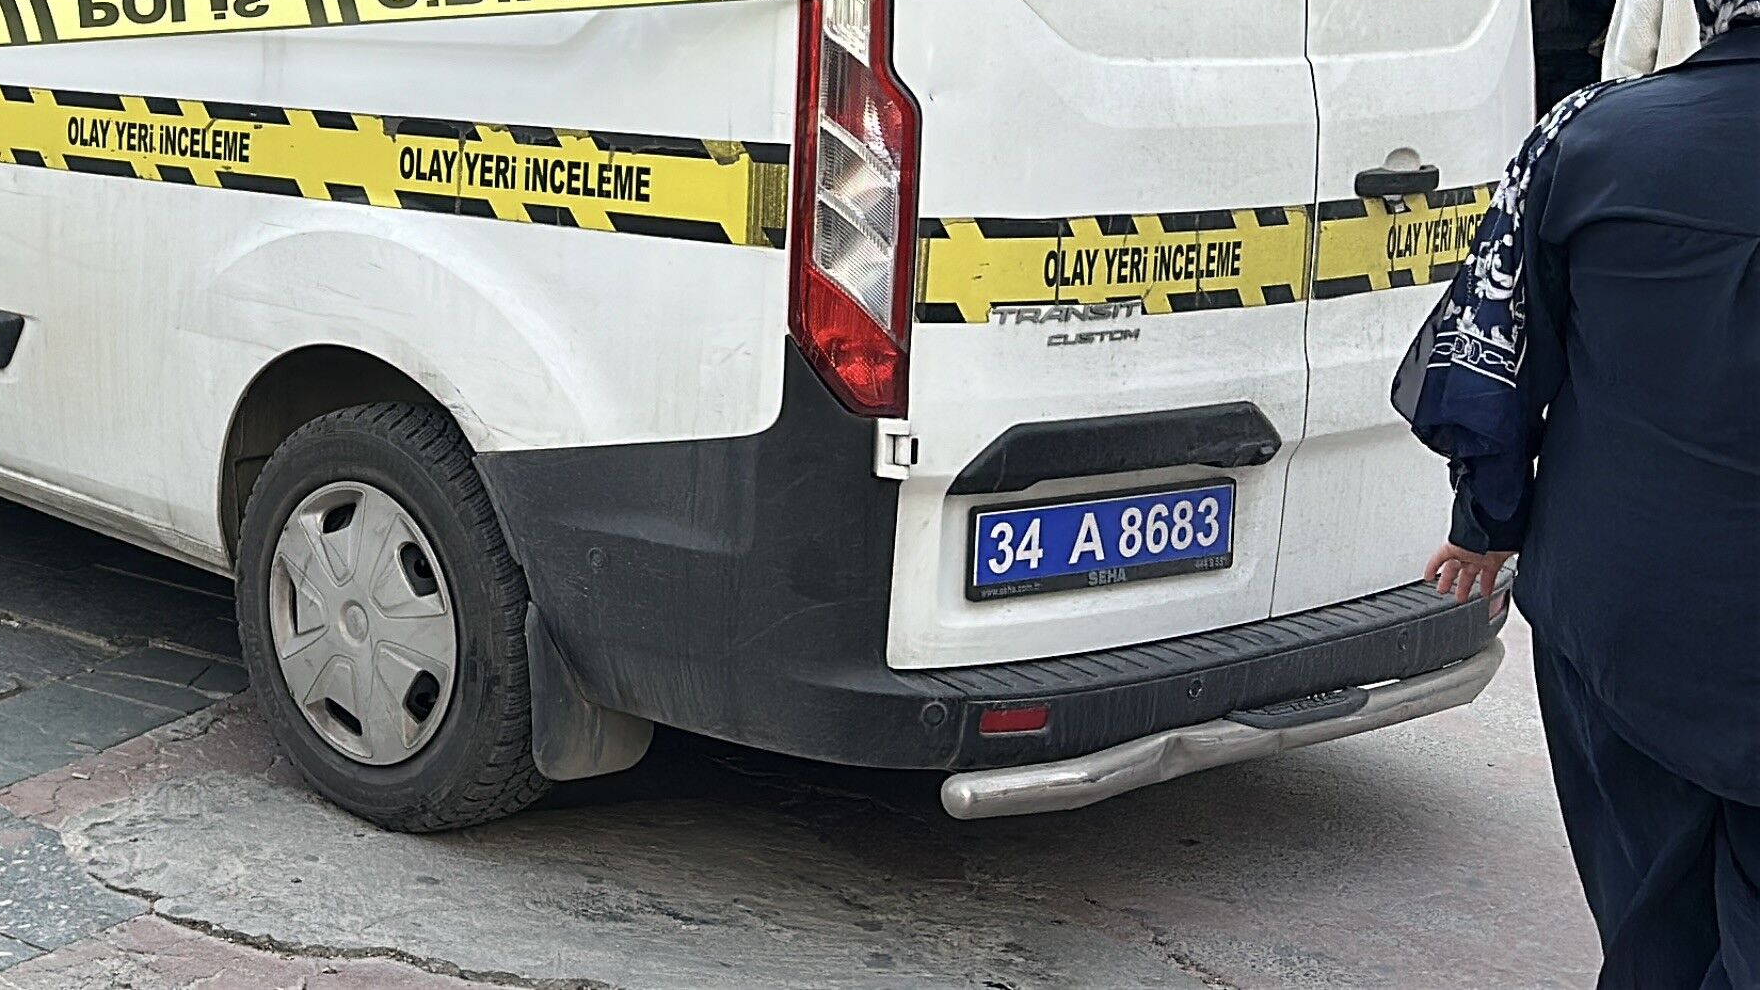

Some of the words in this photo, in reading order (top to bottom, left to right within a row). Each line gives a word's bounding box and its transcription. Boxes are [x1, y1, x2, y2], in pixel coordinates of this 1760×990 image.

[67, 116, 110, 148] OLAY
[398, 145, 460, 185] OLAY
[1386, 222, 1423, 260] OLAY
[1044, 247, 1098, 289] OLAY
[992, 301, 1141, 325] TRANSIT
[1047, 328, 1141, 347] CUSTOM
[988, 518, 1044, 575] 34
[1068, 512, 1106, 565] A
[1118, 497, 1220, 559] 8683
[1088, 567, 1129, 587] SEHA
